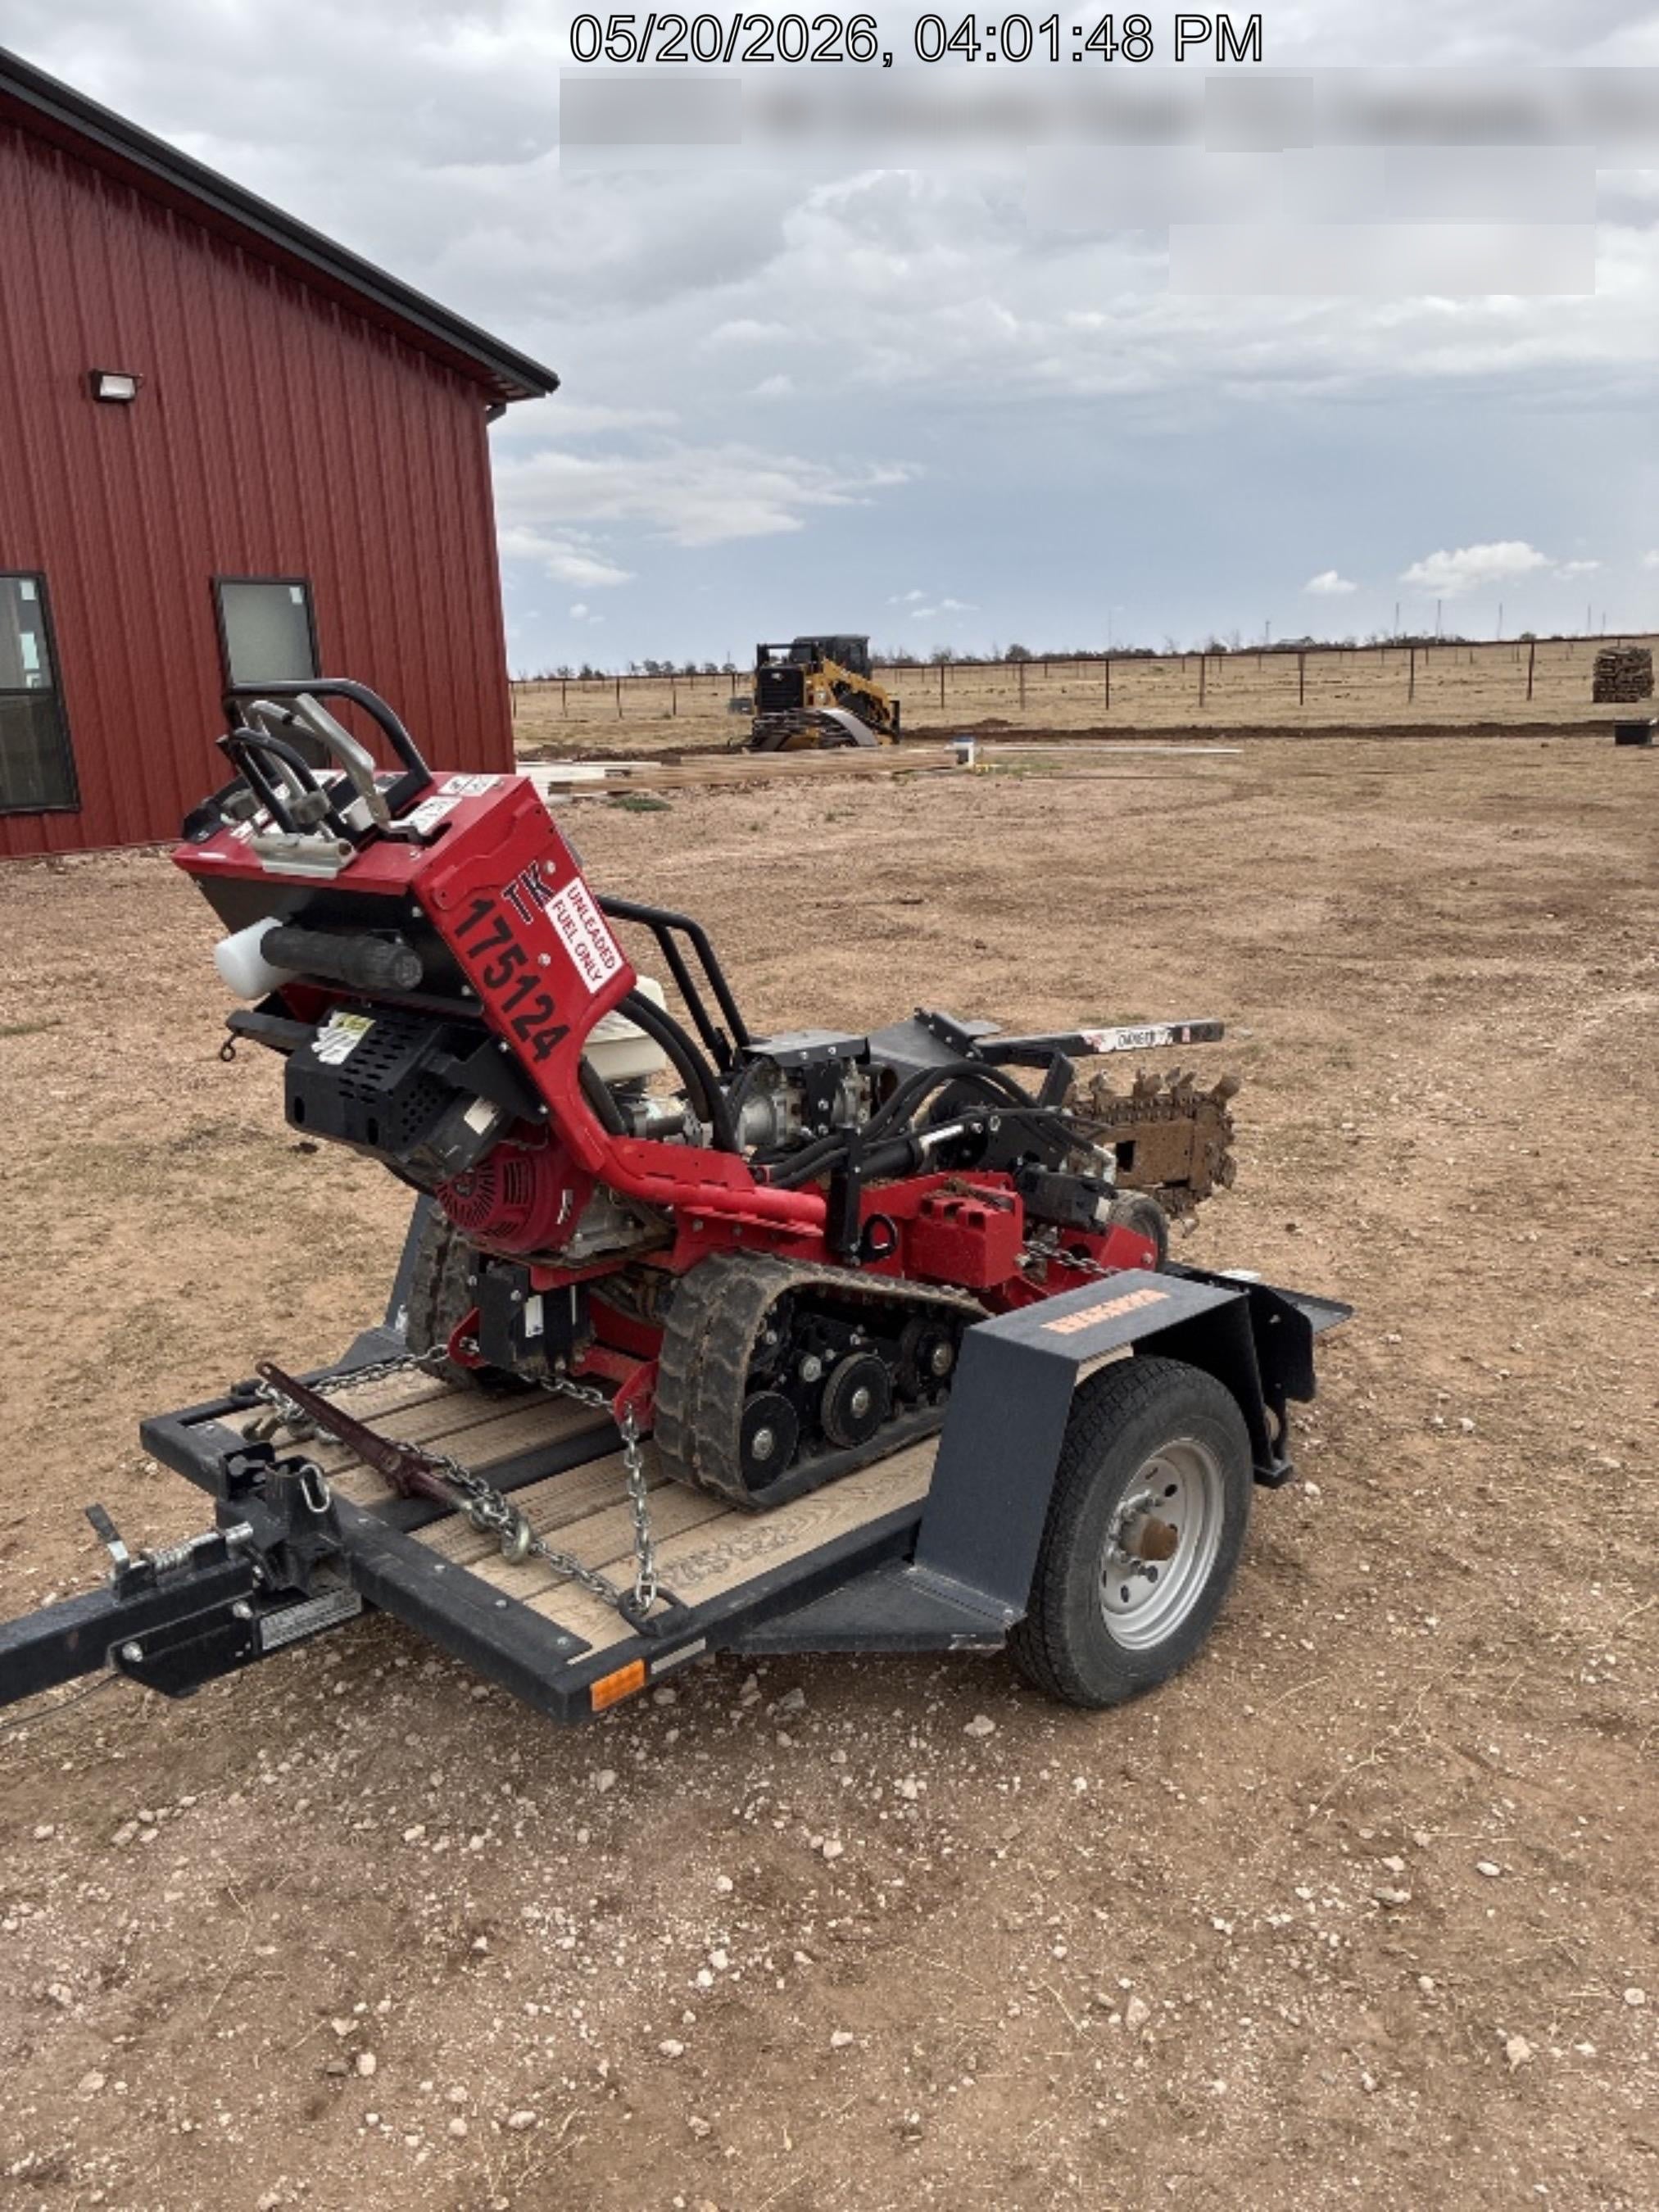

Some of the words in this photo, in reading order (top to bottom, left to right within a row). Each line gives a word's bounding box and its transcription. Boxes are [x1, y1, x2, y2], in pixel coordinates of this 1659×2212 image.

[551, 899, 578, 944] FUEL
[574, 943, 603, 982] ONLY
[566, 885, 615, 970] UNLEADED
[454, 898, 570, 1063] 175124
